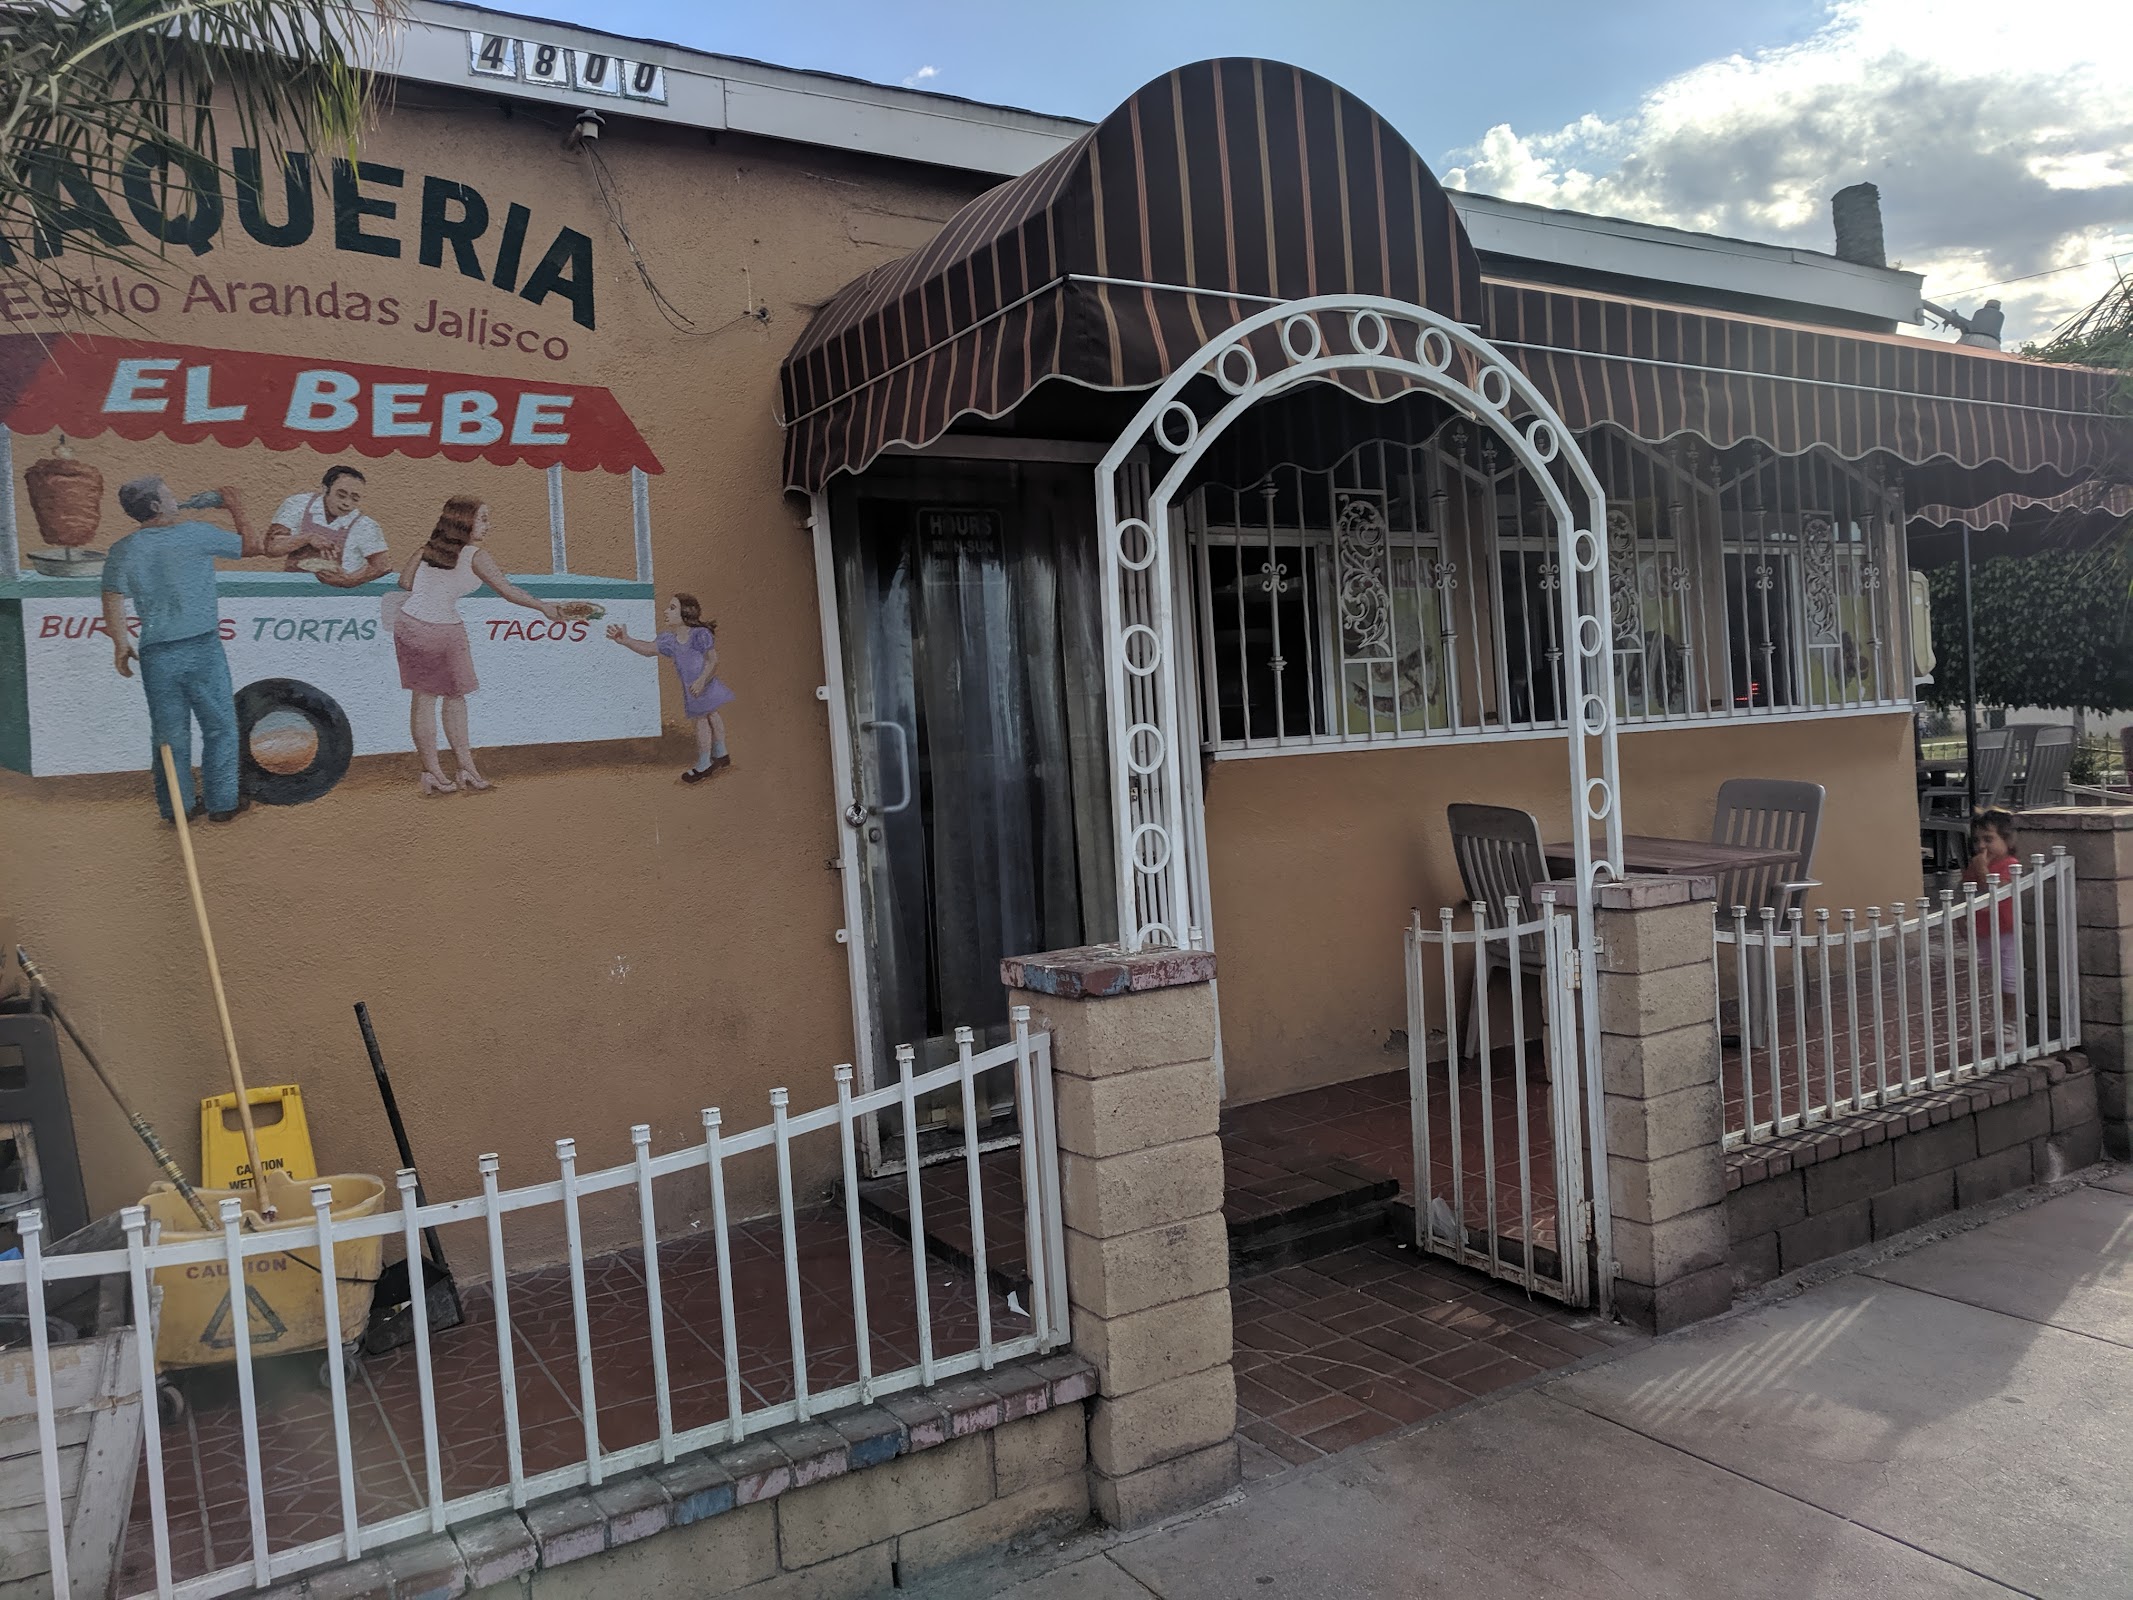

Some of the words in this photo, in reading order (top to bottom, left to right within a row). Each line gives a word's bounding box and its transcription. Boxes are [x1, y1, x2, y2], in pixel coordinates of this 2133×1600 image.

[481, 37, 656, 93] 4800
[0, 141, 596, 331] AQUERIA
[0, 275, 160, 322] Estilo
[182, 274, 400, 326] Arandas
[414, 299, 570, 361] Jalisco
[102, 357, 247, 425] EL
[283, 368, 575, 446] BEBE
[39, 615, 236, 640] BURRS
[252, 616, 378, 643] TORTAS
[485, 619, 590, 642] TACOS
[236, 1158, 284, 1176] CATION
[186, 1257, 287, 1279] CAUION
